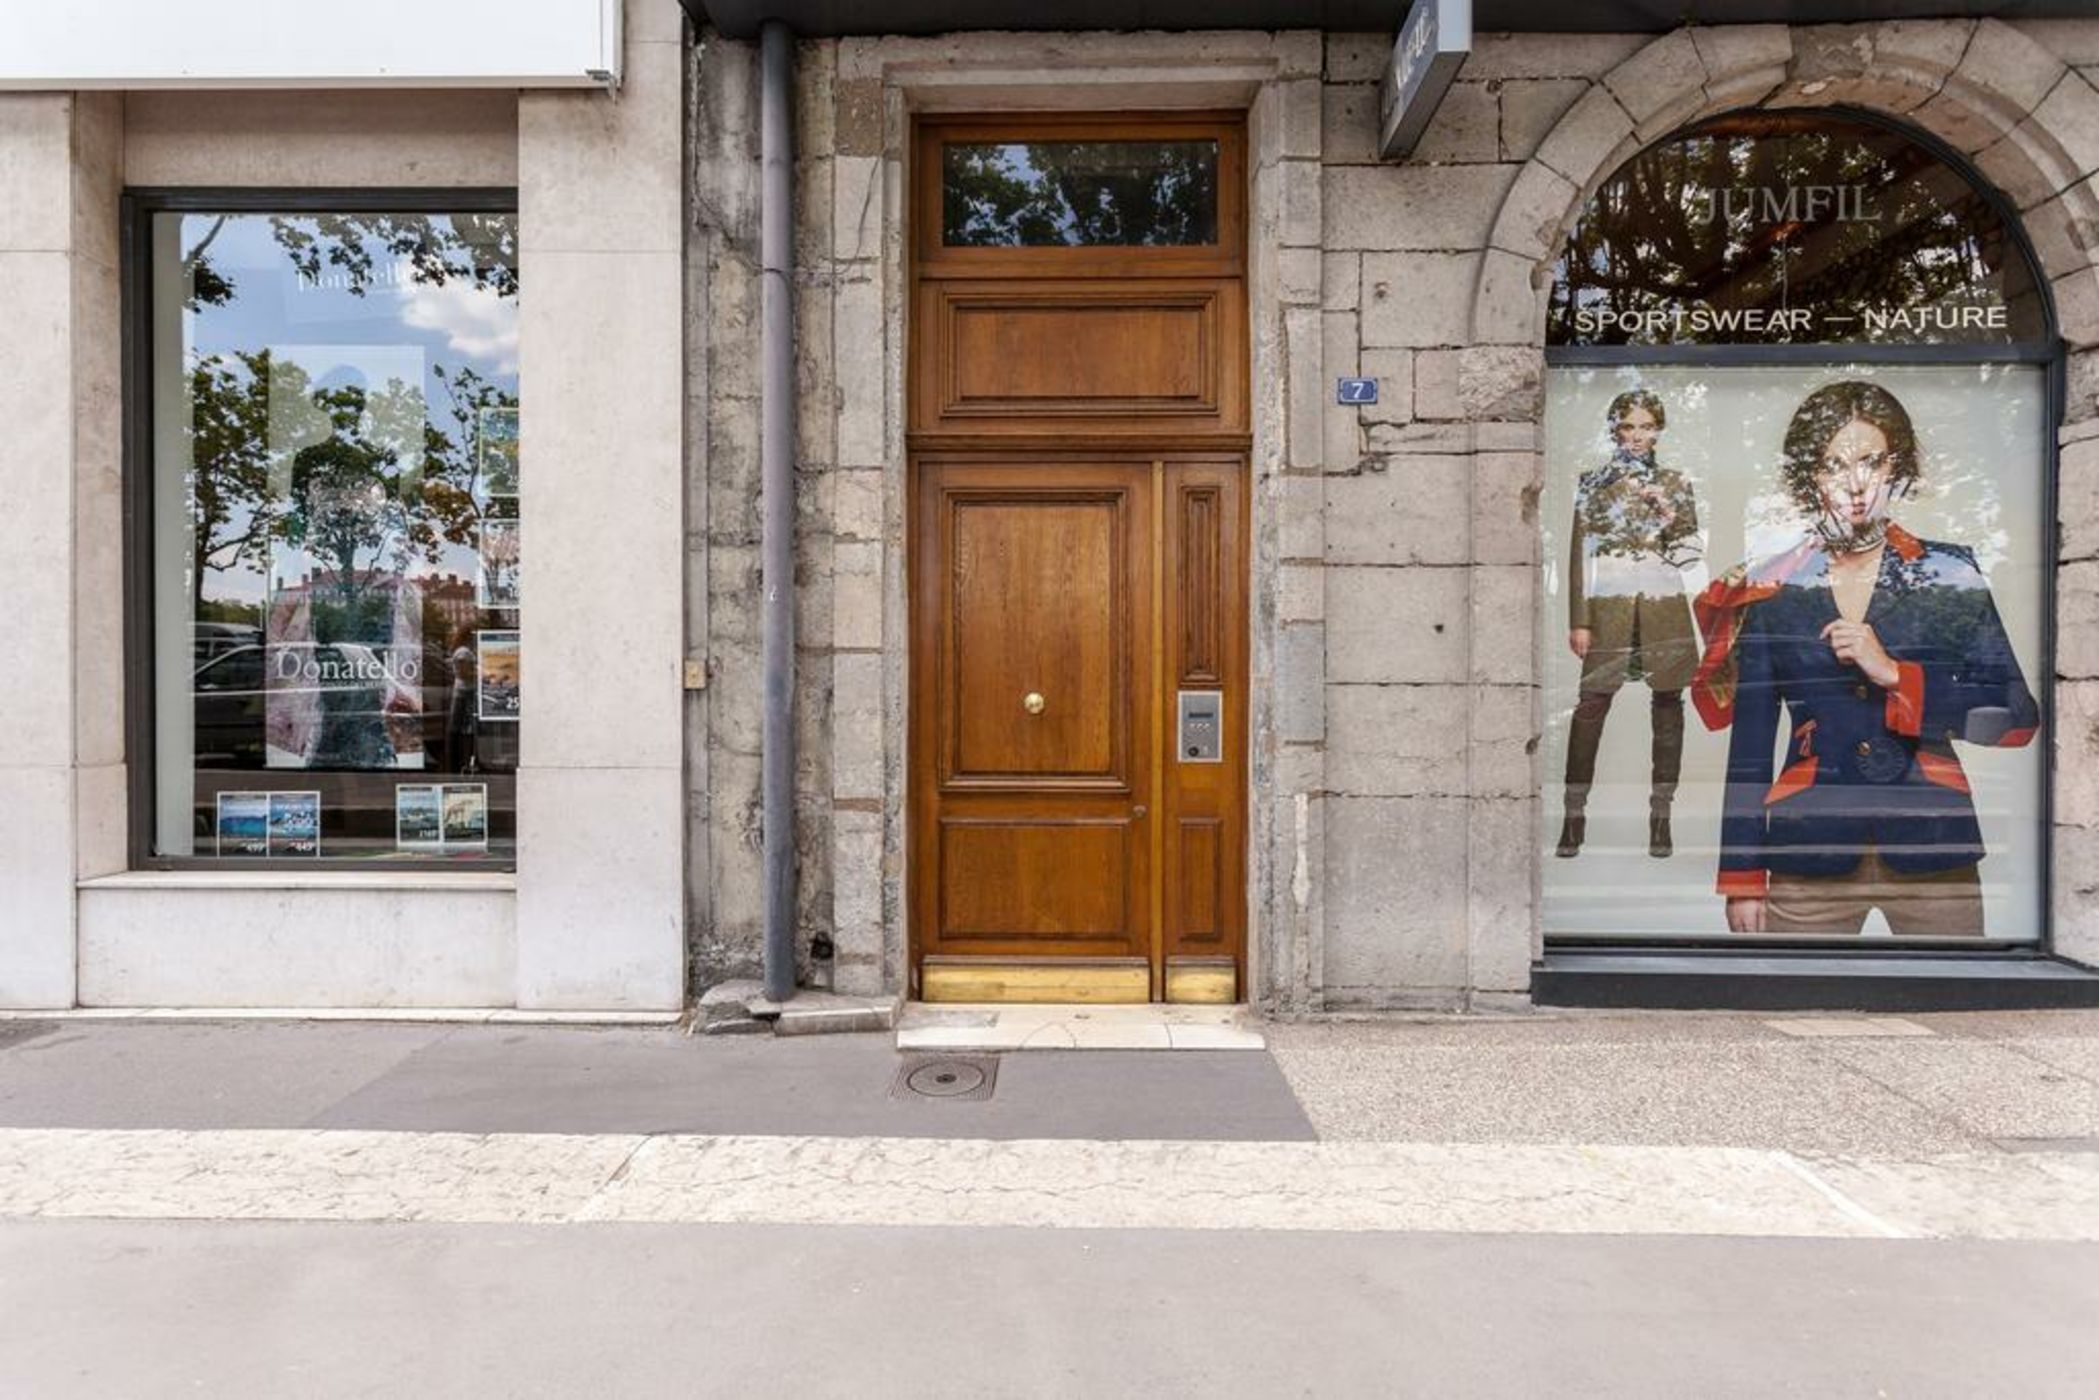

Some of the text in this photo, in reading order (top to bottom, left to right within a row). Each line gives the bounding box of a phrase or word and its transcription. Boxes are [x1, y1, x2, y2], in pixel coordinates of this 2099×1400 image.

[1695, 184, 1883, 225] JUMFIL
[1573, 308, 1812, 333] SPORTSWEAR
[1863, 306, 2007, 330] NATURE
[1351, 382, 1364, 399] 7
[276, 650, 418, 681] Donatello
